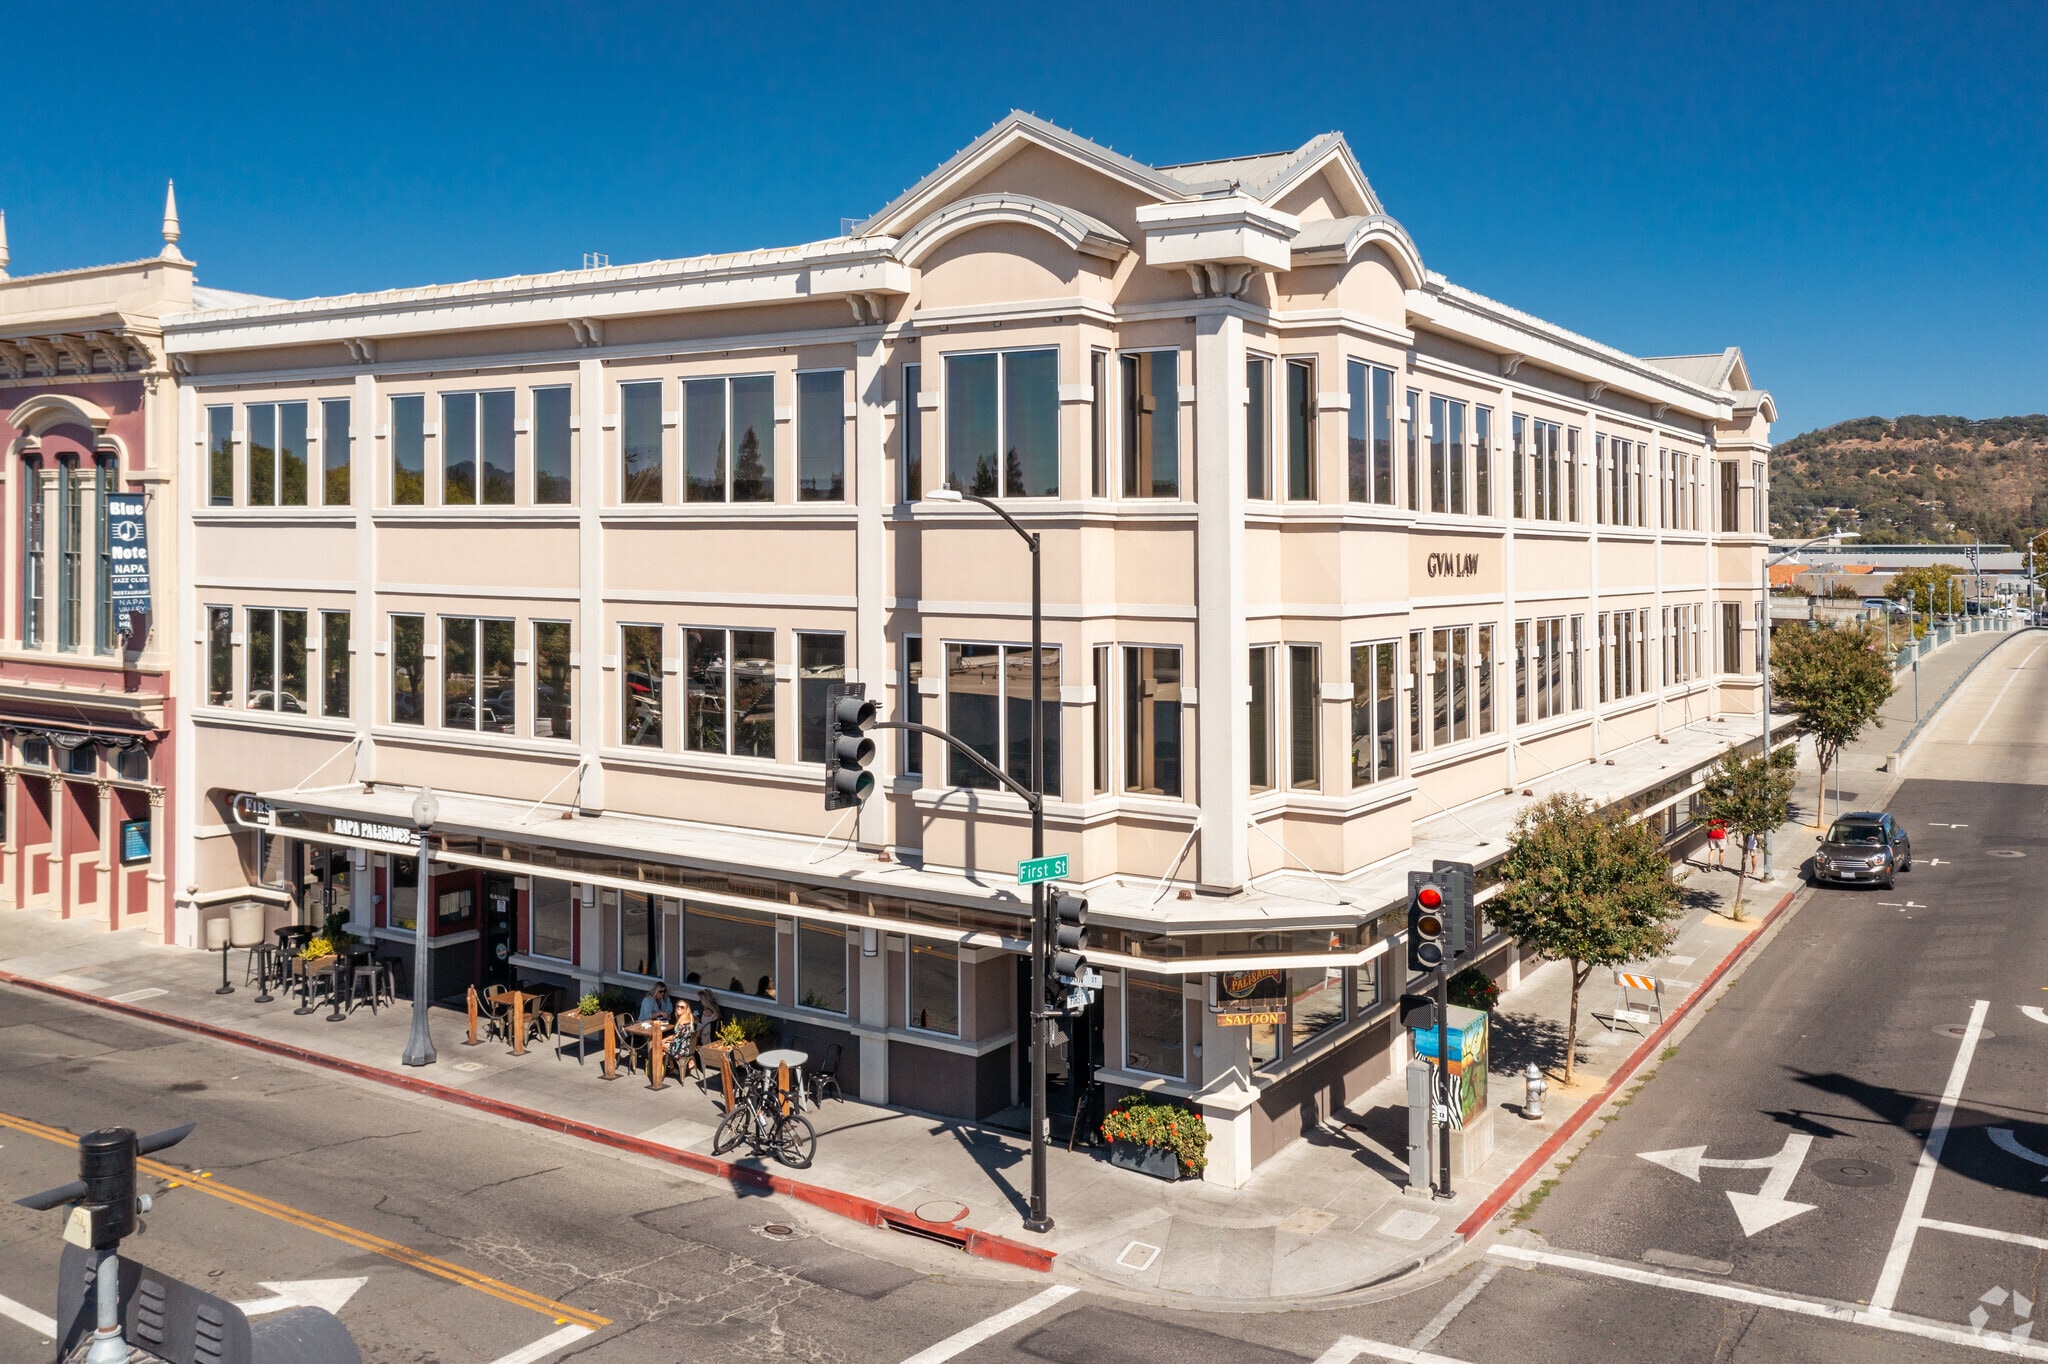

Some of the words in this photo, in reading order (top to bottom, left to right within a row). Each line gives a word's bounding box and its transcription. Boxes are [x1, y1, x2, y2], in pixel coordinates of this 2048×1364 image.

[110, 502, 144, 515] Blue
[112, 546, 148, 560] Note
[114, 564, 146, 574] NAPA
[1427, 552, 1454, 578] GVM
[1455, 553, 1479, 578] LAW
[244, 798, 271, 814] FIRS
[334, 818, 360, 837] NAPA
[1020, 864, 1048, 880] First
[1055, 860, 1066, 874] St
[490, 893, 510, 901] SALOO
[1091, 976, 1097, 984] ST
[1225, 1013, 1279, 1026] SALOON
